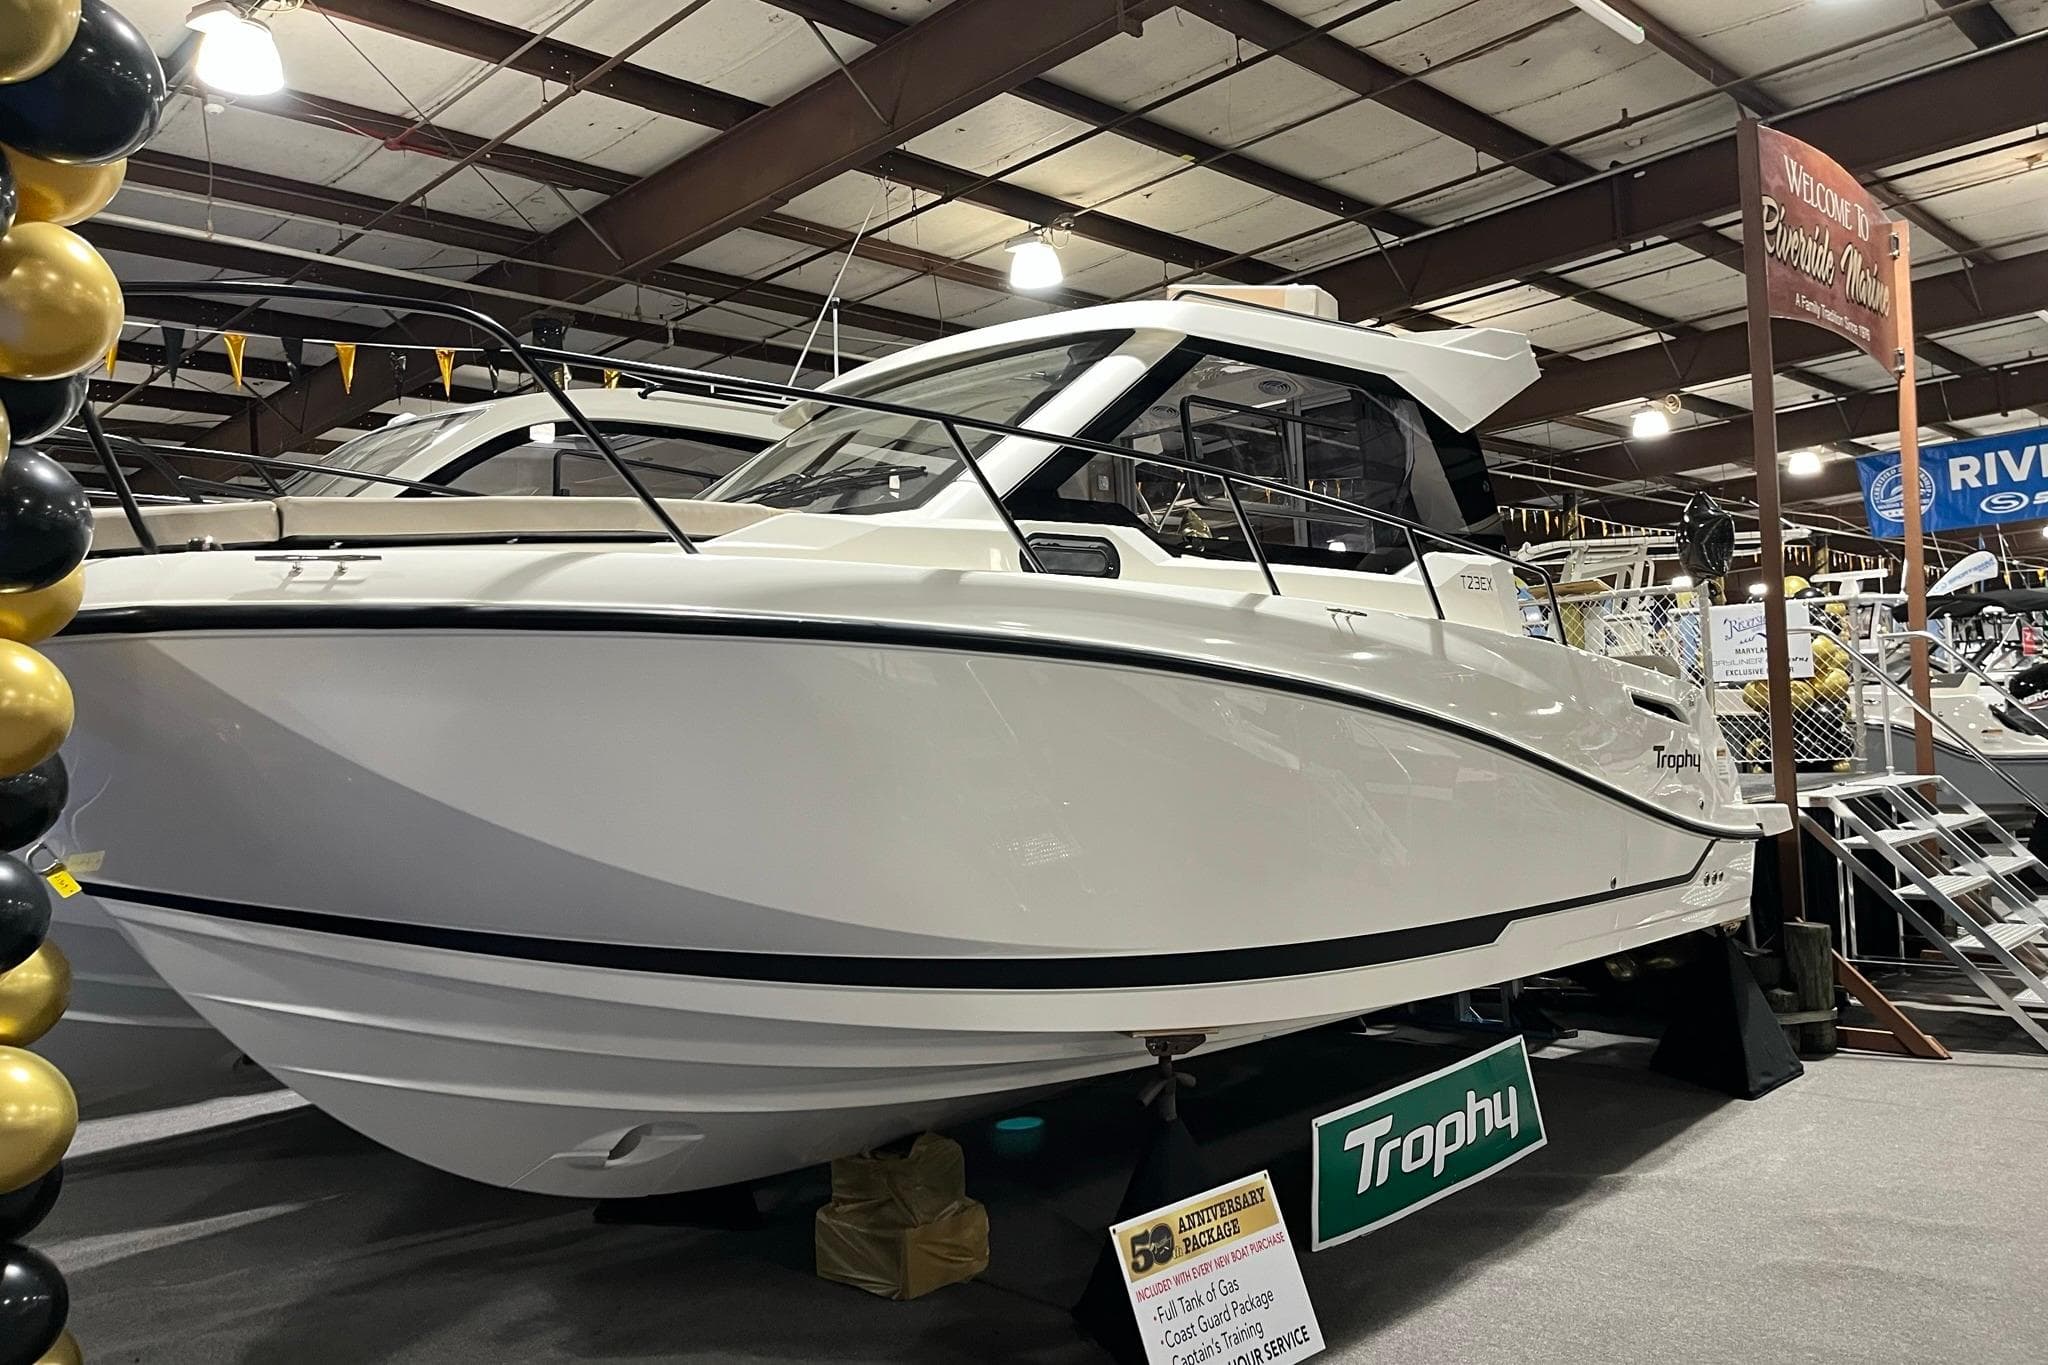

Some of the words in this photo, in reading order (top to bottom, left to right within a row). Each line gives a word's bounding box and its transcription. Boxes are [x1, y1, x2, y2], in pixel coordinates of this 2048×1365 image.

[1783, 154, 1853, 231] WELCOME
[1761, 194, 1835, 287] Riverside
[1840, 242, 1891, 318] Marine
[1795, 292, 1801, 307] A
[1801, 294, 1821, 319] Family
[1820, 303, 1844, 327] Tradition
[1460, 574, 1494, 592] T23EX
[1725, 668, 1764, 677] EXCLUSIVE
[1653, 745, 1701, 774] Trophy
[1343, 1086, 1520, 1196] Trophy
[1178, 1186, 1266, 1235] ANNIVERSARY
[1182, 1217, 1241, 1255] PACKAGE
[1136, 1278, 1172, 1303] INCLUDED
[1172, 1269, 1192, 1287] WITH
[1192, 1259, 1214, 1281] EVERY
[1213, 1252, 1232, 1270] NEW
[1231, 1243, 1251, 1263] BOAT
[1250, 1231, 1286, 1255] PURCHASE
[1157, 1300, 1178, 1325] Full
[1177, 1288, 1204, 1314] Tank
[1206, 1281, 1218, 1303] of
[1218, 1278, 1241, 1299] Gas
[1164, 1322, 1198, 1348] Coast
[1197, 1306, 1232, 1333] Guard
[1232, 1288, 1275, 1321] Package
[1220, 1320, 1264, 1350] Training
[1263, 1324, 1310, 1361] SERVICE
